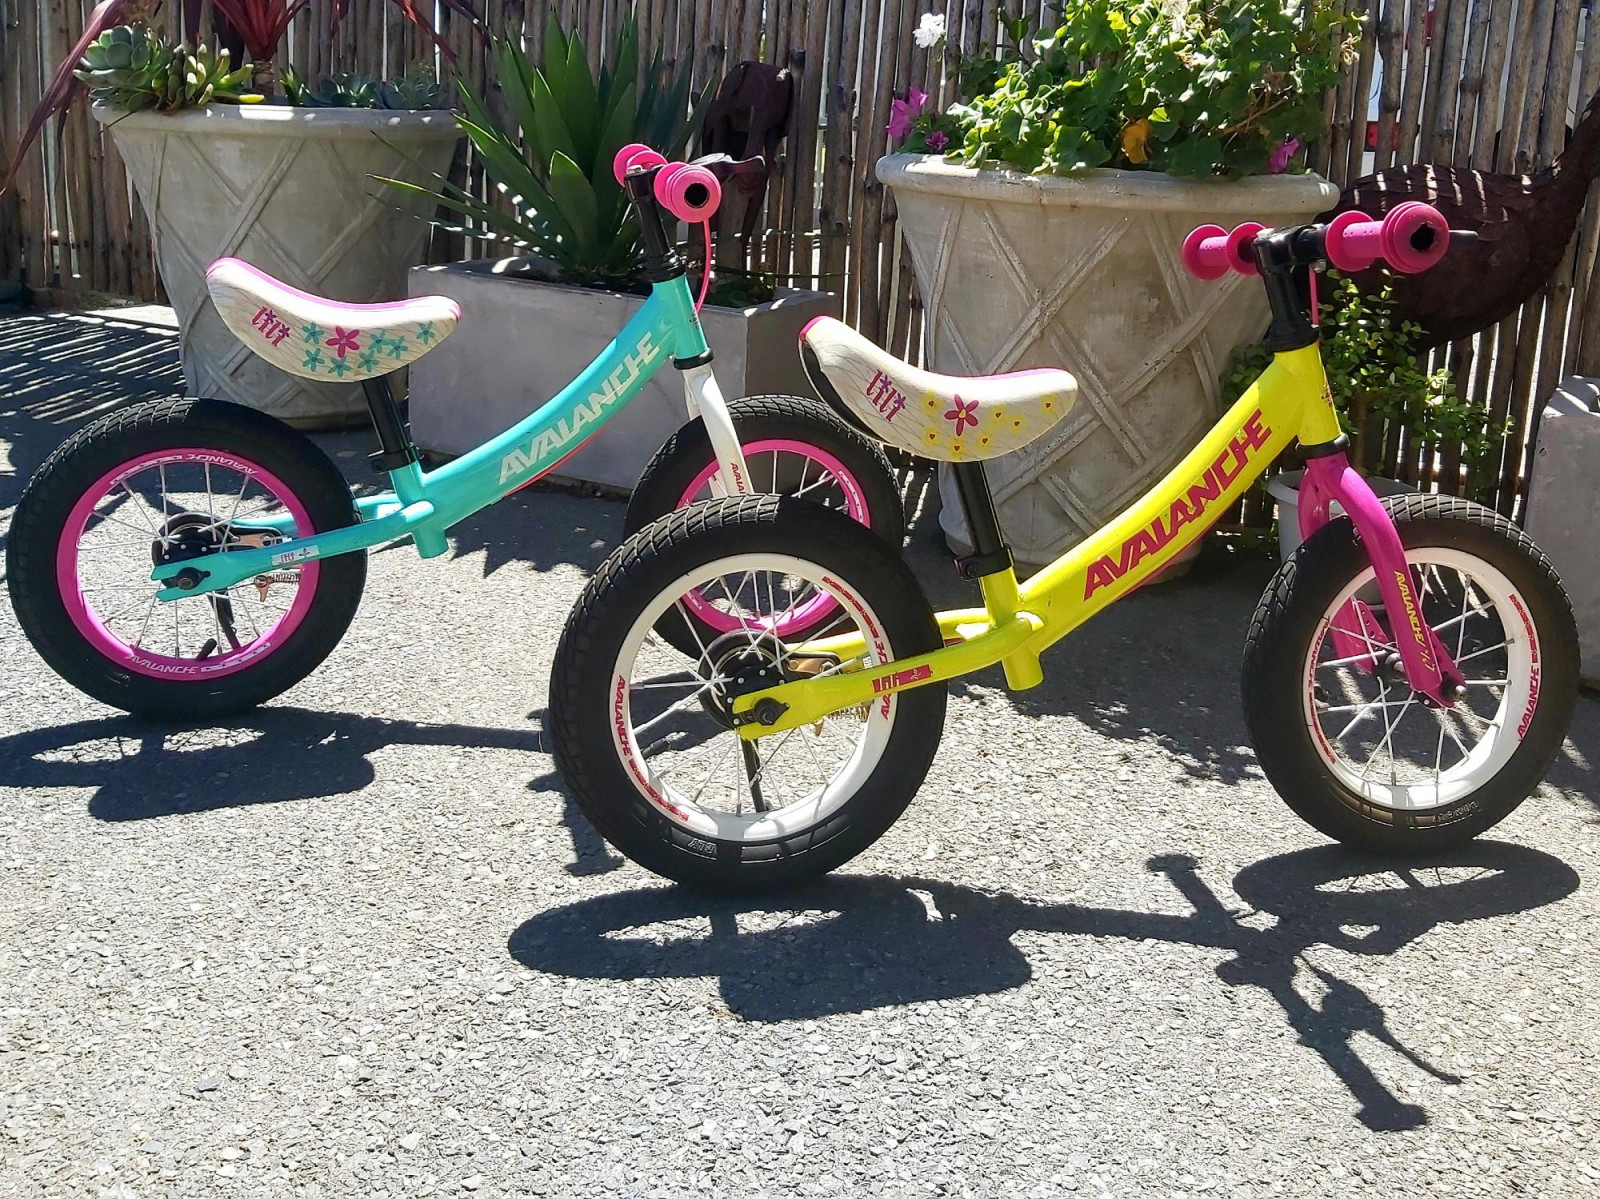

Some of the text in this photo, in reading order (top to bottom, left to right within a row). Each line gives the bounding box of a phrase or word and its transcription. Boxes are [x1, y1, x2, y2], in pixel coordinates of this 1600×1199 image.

[499, 331, 660, 485] AVALANCHE
[185, 453, 259, 475] AVALANCHE
[1083, 408, 1272, 600] AVALANCHE
[126, 653, 200, 675] AVALANCHE
[613, 674, 634, 756] AVALANCHE
[1517, 666, 1541, 743] AVALANCHE
